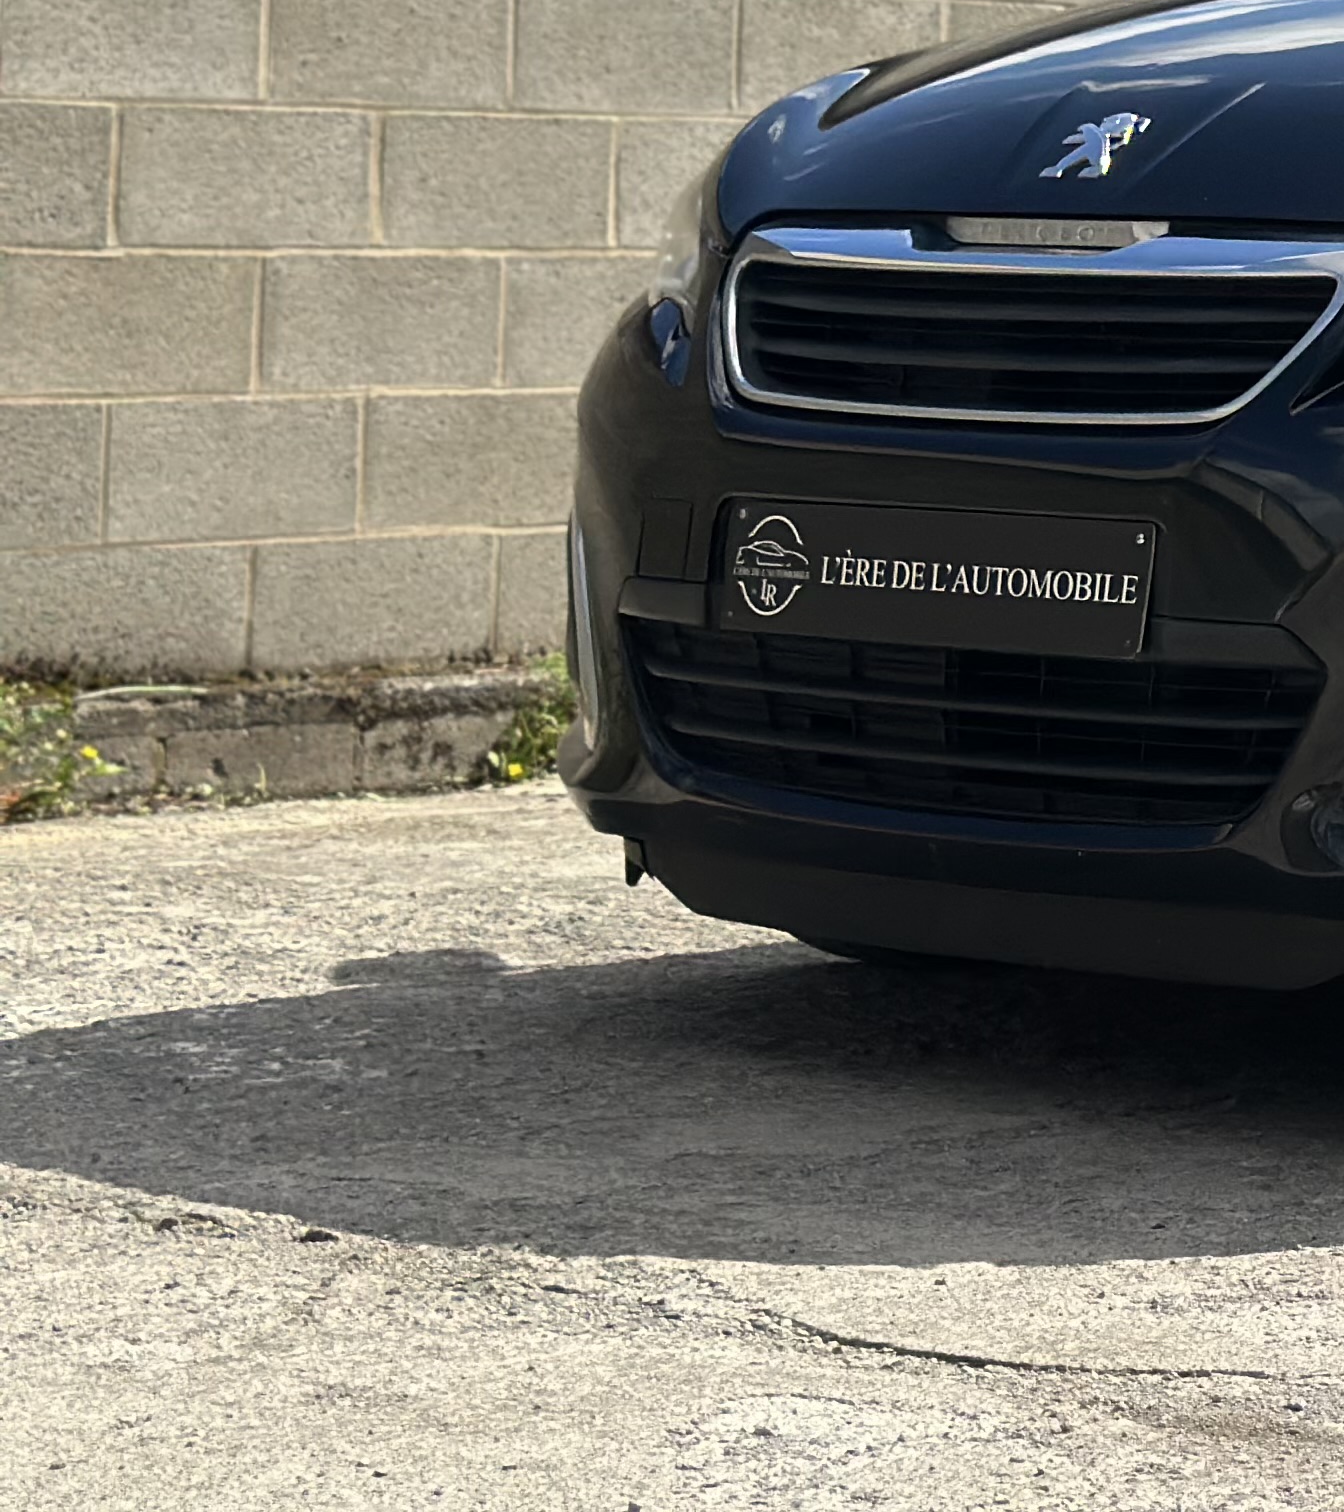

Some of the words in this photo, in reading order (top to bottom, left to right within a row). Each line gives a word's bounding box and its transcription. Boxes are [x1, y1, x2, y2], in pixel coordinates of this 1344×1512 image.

[820, 550, 888, 589] L'ÈRE
[892, 560, 926, 591] DE
[930, 563, 1139, 605] L'AUTOMOBILE
